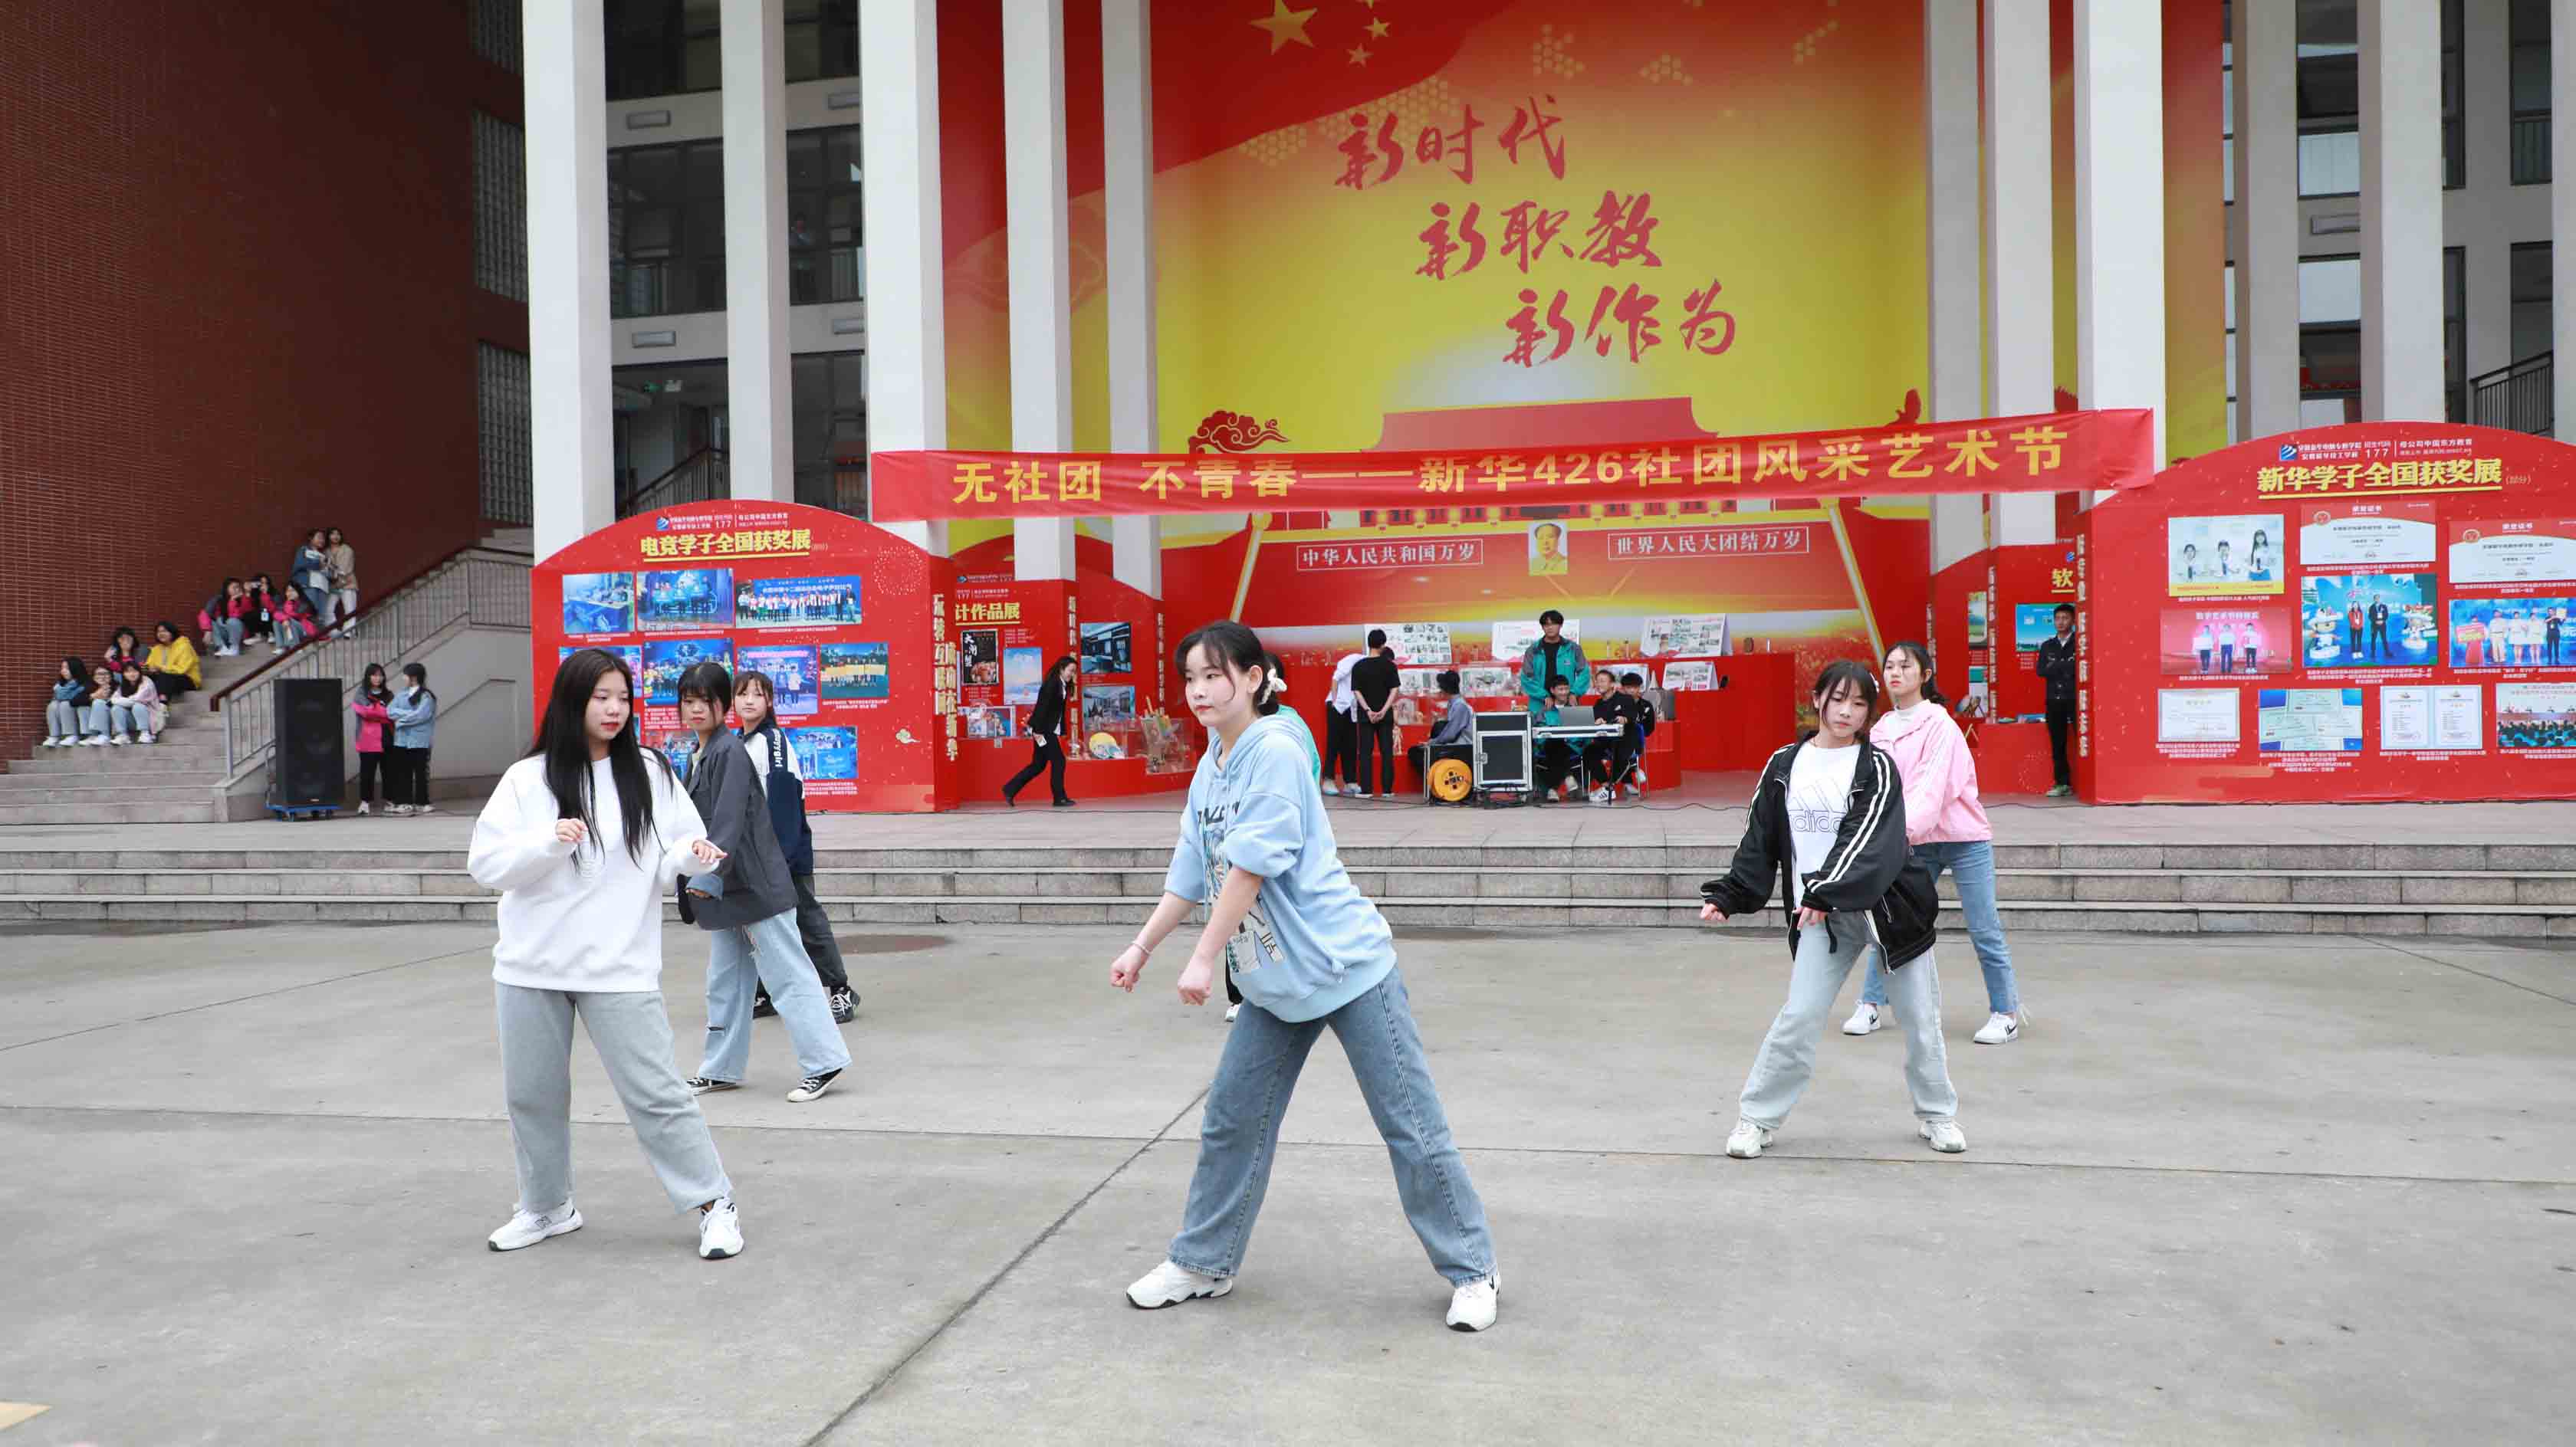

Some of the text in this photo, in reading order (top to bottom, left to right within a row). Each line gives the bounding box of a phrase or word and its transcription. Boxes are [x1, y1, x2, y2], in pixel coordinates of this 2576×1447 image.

[1335, 94, 1565, 190] 新时代
[1415, 190, 1662, 281] 新职教
[1502, 279, 1736, 367] 新作为
[2366, 448, 2389, 459] 177
[952, 461, 1102, 504] 无社团
[2257, 458, 2502, 492] 新华学子全国获奖展
[715, 520, 731, 529] 177
[640, 529, 810, 556] 电竞学子全国获奖展
[1302, 541, 1478, 568] 中华人民共和国万岁
[1617, 529, 1804, 556] 世界人民大团结万岁
[2052, 568, 2074, 588] 软
[955, 602, 1020, 622] 计作品展
